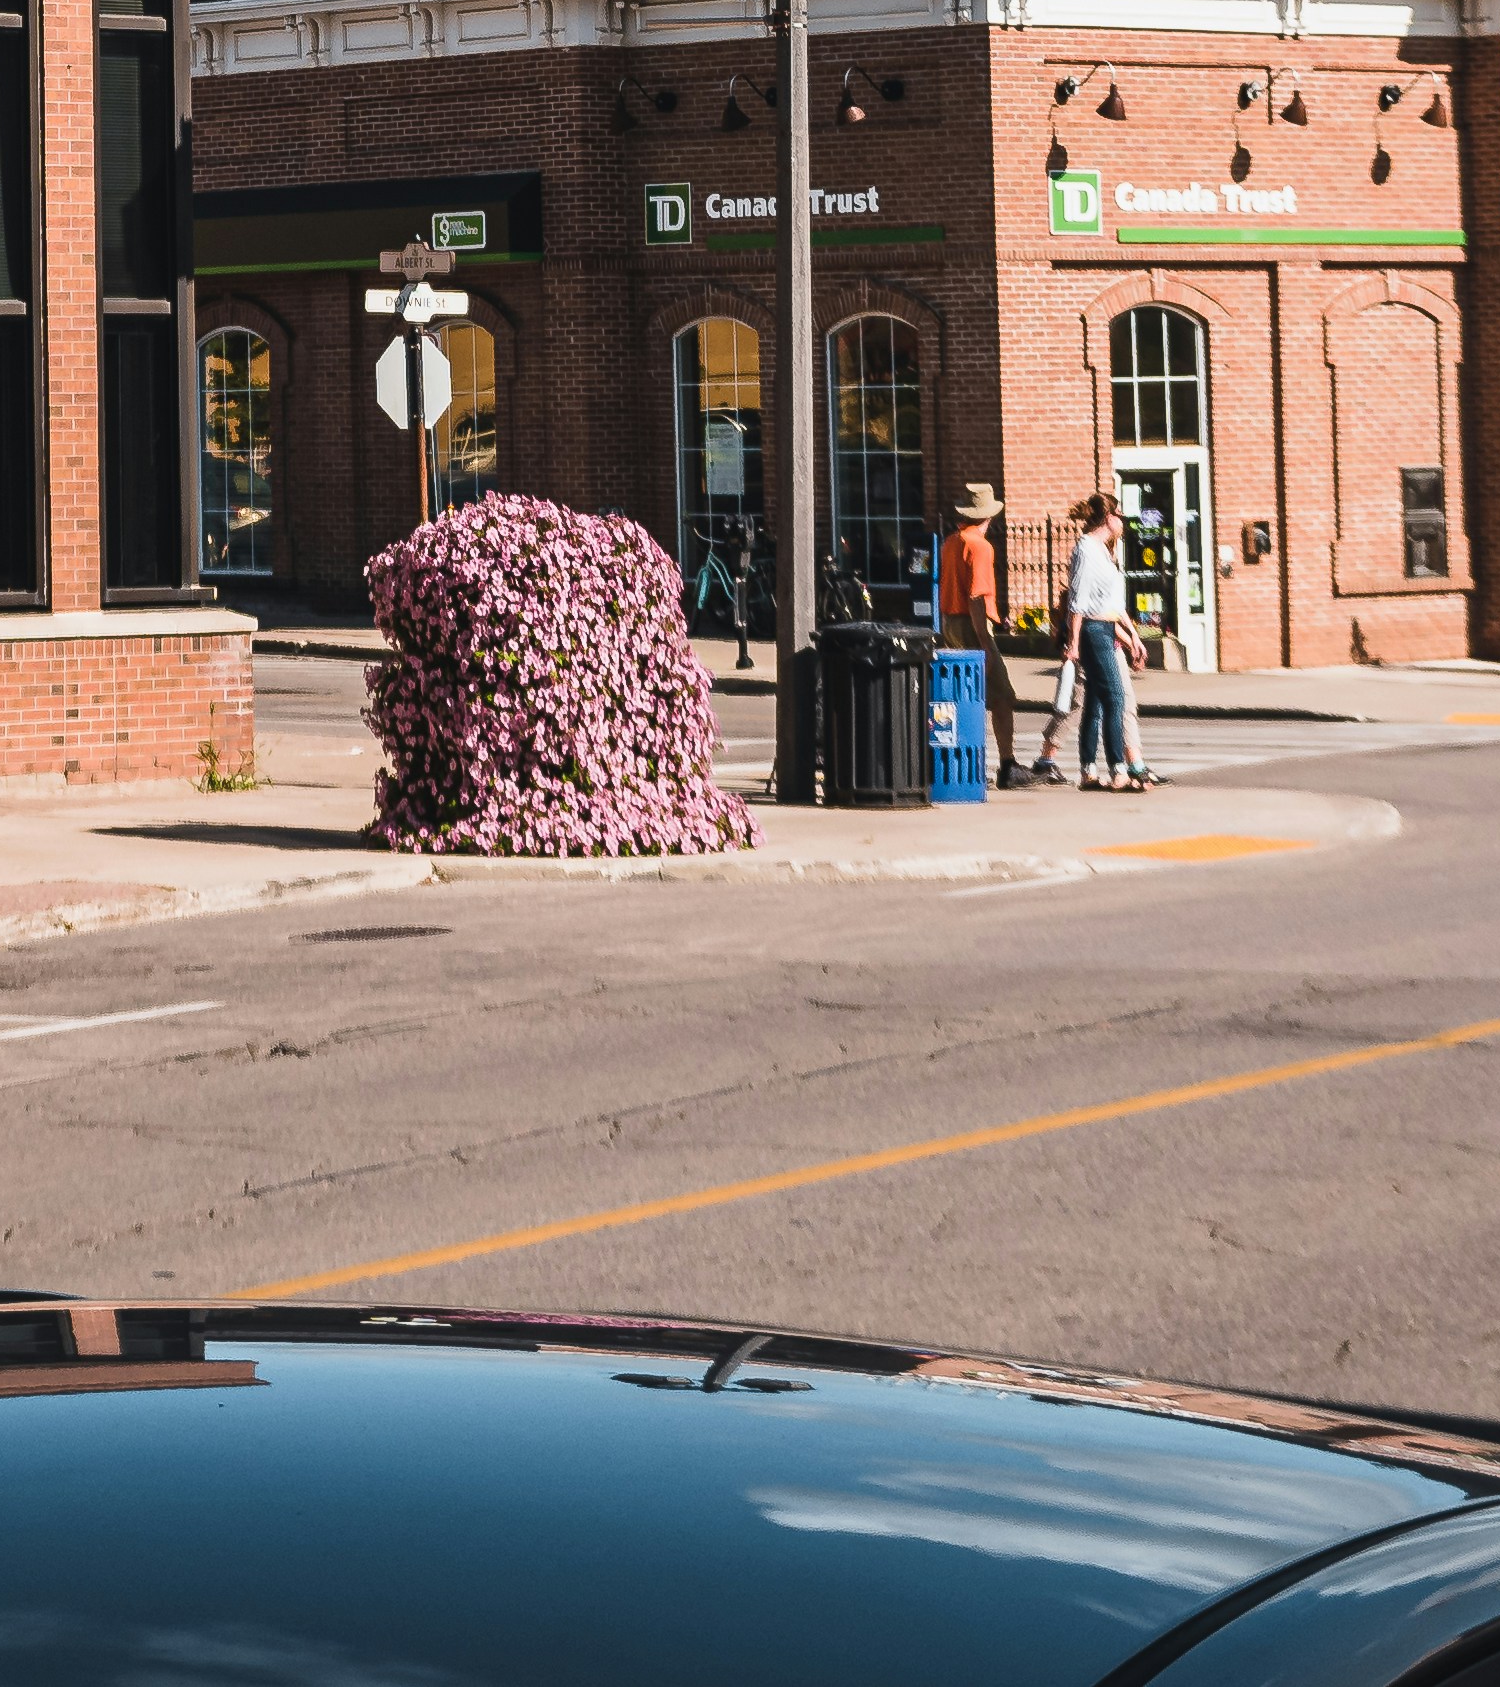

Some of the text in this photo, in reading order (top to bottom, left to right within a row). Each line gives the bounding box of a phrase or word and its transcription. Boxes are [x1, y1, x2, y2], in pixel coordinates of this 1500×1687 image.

[649, 186, 880, 232] TD Cana Trust
[1054, 181, 1297, 222] TD Canada Trust
[394, 256, 423, 269] ALBERT
[385, 296, 431, 308] DOWNIE
